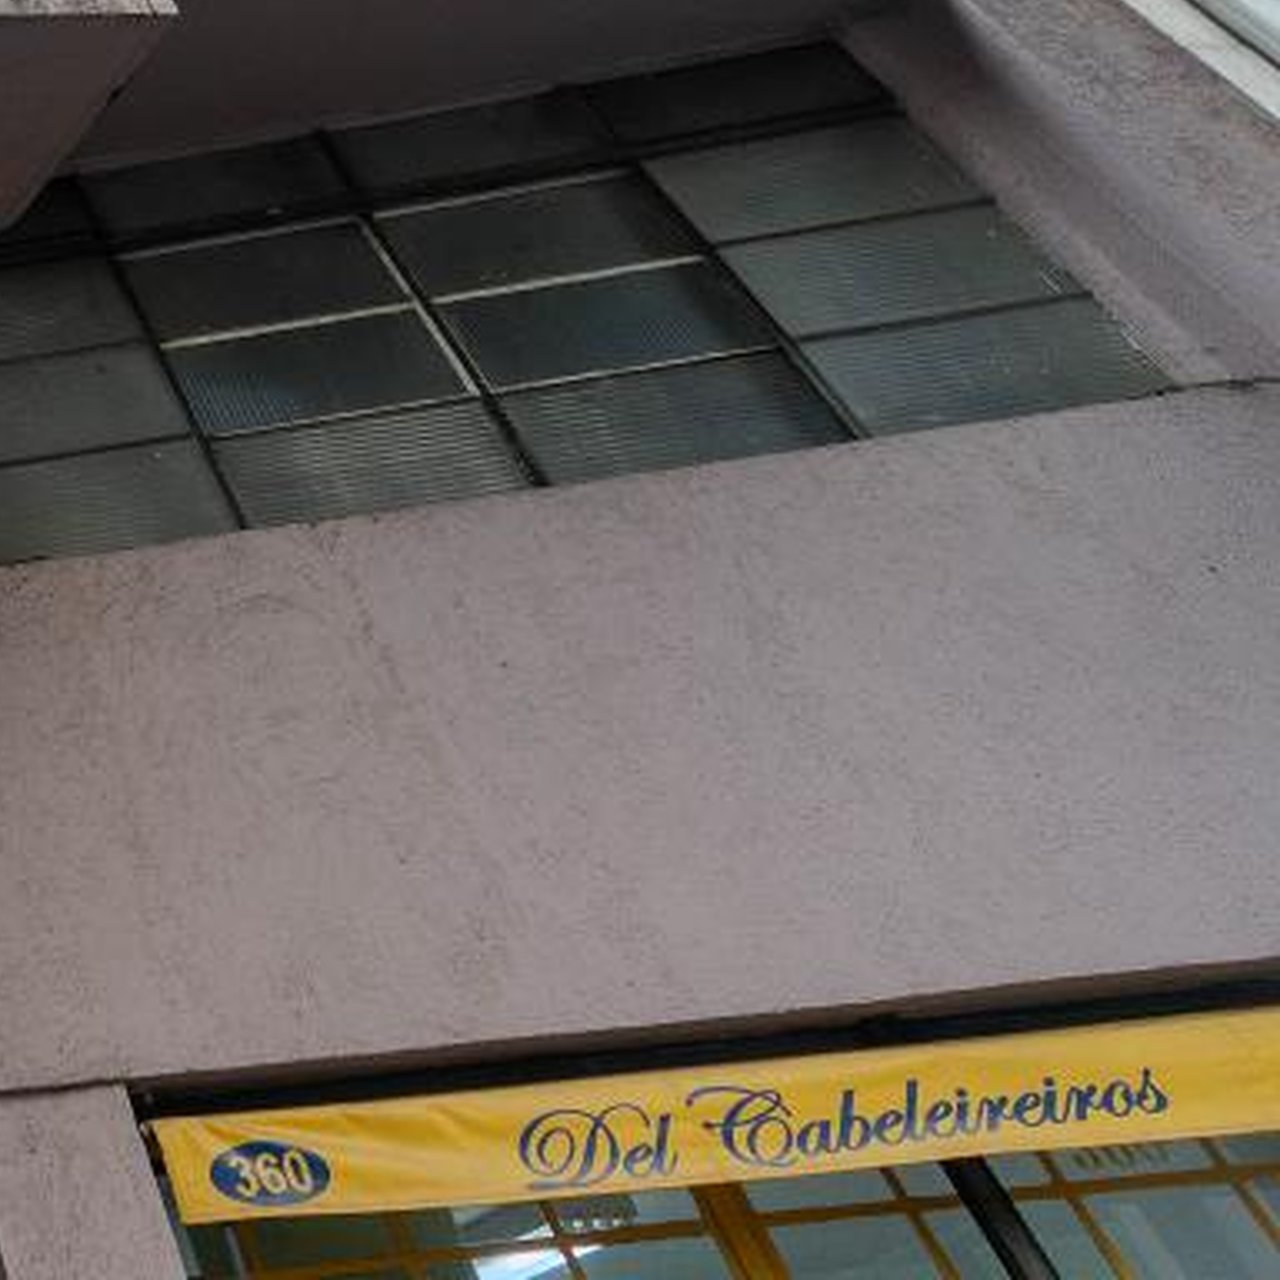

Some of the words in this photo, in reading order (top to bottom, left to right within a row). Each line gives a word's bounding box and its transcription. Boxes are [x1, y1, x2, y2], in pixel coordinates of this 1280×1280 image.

[517, 1103, 680, 1190] Del
[685, 1068, 1170, 1168] Cabeleireiros
[227, 1148, 315, 1198] 360
